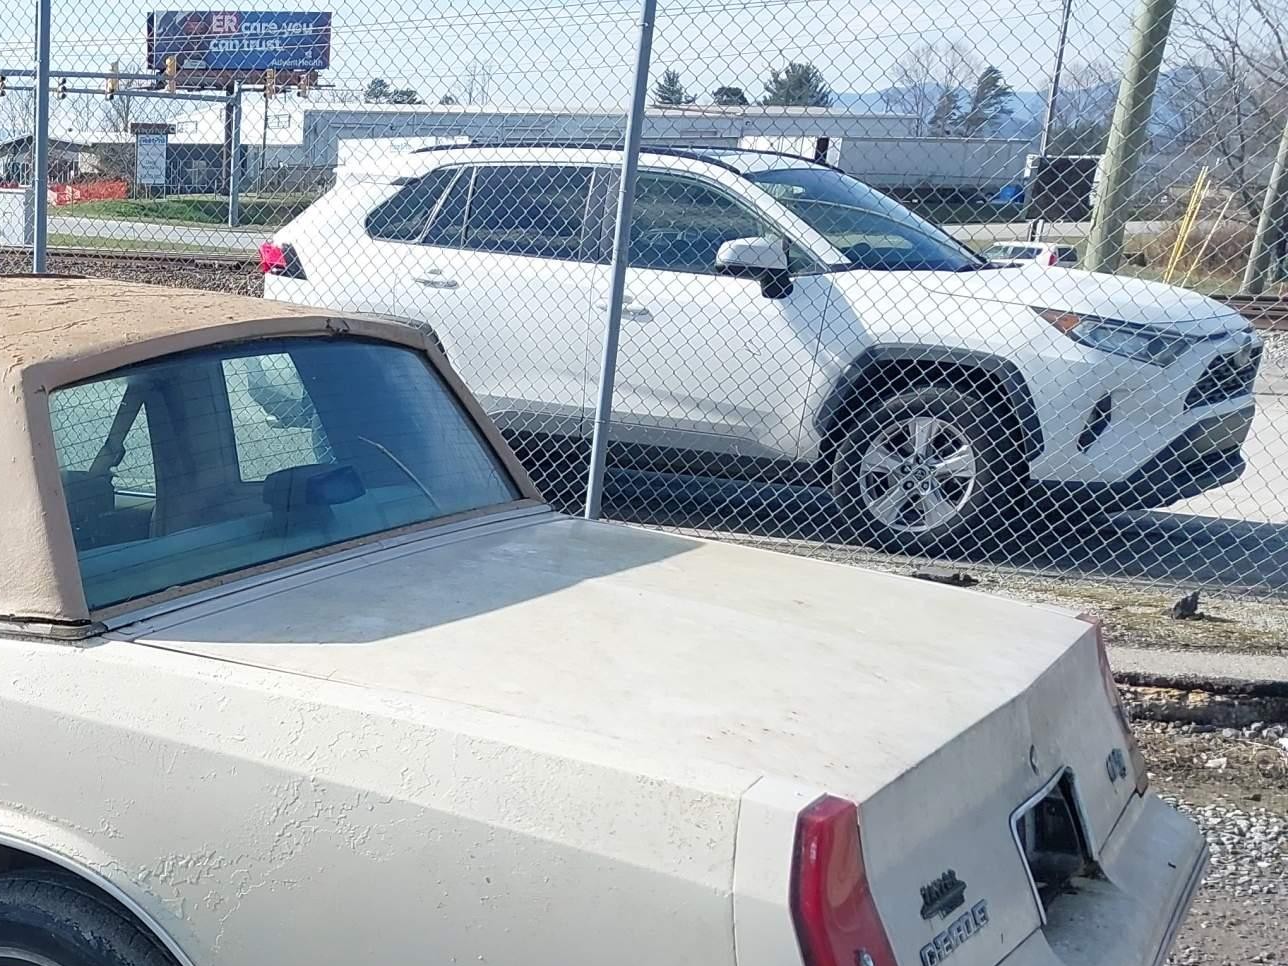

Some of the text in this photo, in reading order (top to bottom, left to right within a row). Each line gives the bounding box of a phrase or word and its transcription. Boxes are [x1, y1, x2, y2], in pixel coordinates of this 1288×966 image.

[212, 14, 313, 38] ER care you
[209, 39, 241, 51] can
